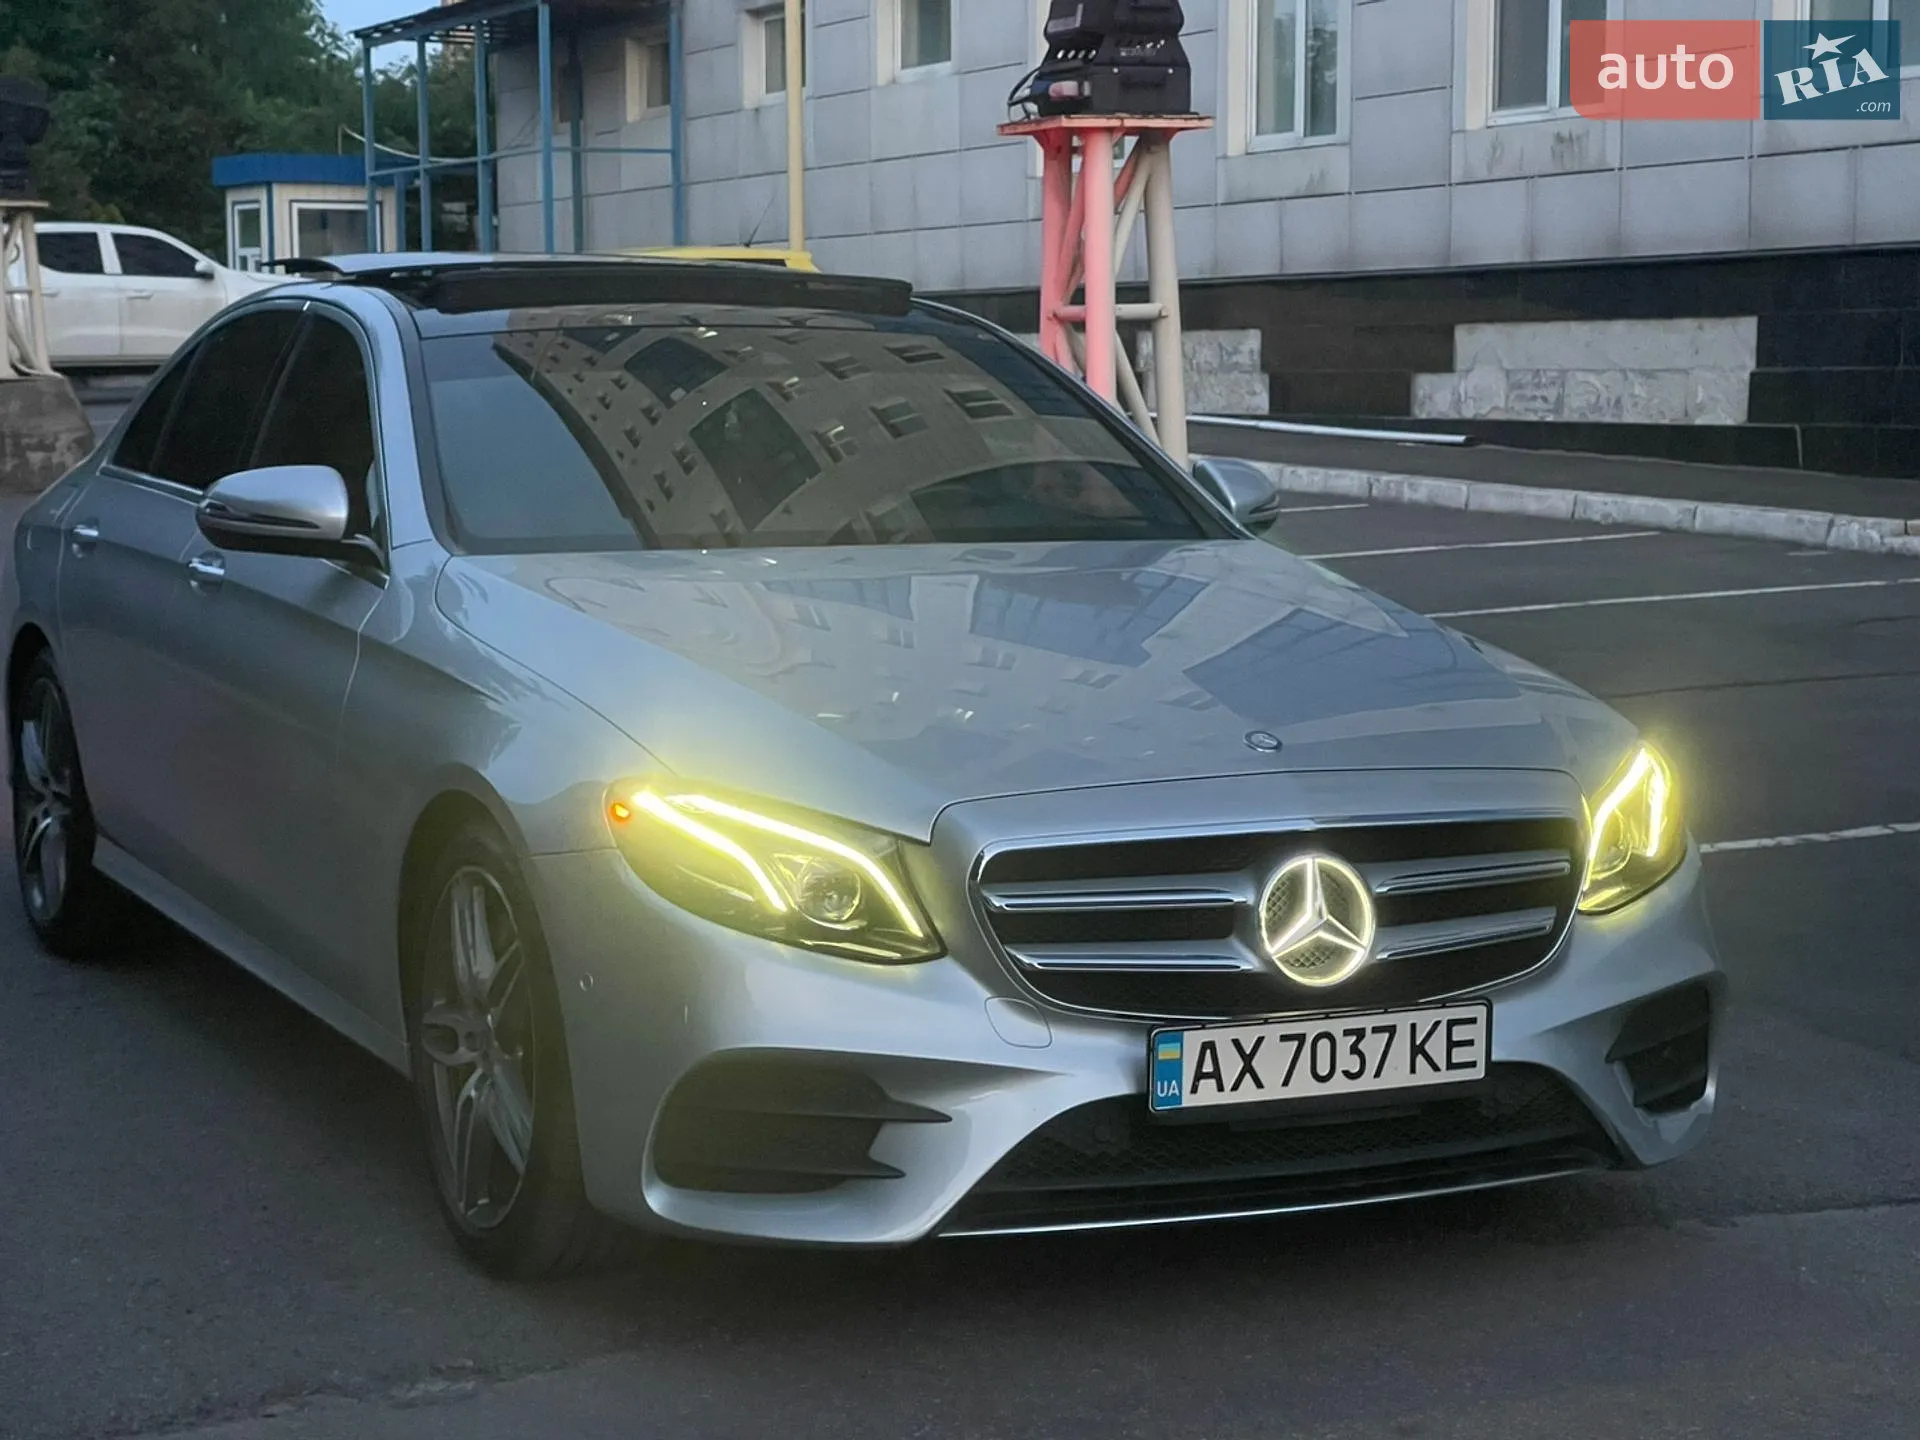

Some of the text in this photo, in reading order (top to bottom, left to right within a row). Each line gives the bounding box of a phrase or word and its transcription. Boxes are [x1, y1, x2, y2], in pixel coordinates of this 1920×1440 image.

[1189, 1016, 1479, 1095] AX 7037 KE
[1156, 1079, 1180, 1097] UA
